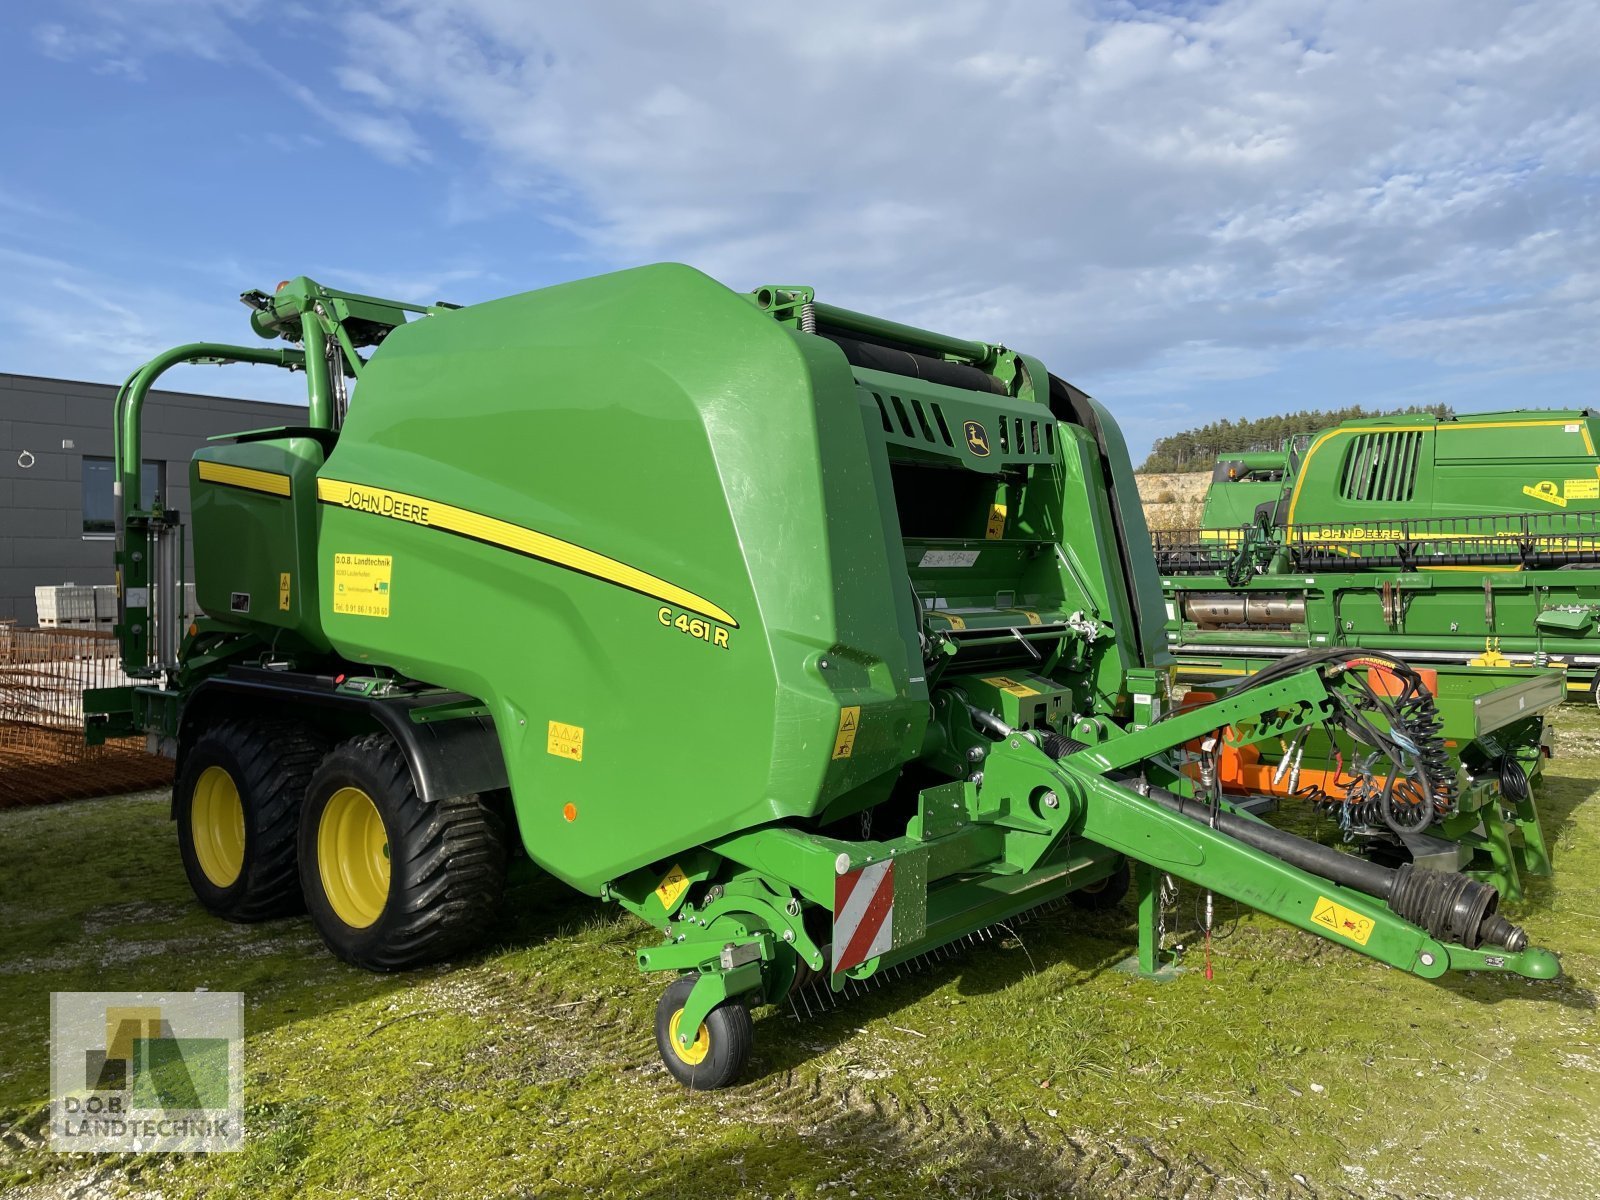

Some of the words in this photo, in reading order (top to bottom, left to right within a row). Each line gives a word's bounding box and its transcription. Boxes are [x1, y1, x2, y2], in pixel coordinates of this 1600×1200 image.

[344, 487, 379, 510] JOHN
[383, 495, 429, 522] DEERE
[1353, 527, 1401, 539] DEERE
[354, 556, 391, 567] Landtechnik
[658, 606, 672, 627] C
[674, 613, 711, 642] 461
[713, 625, 729, 650] R
